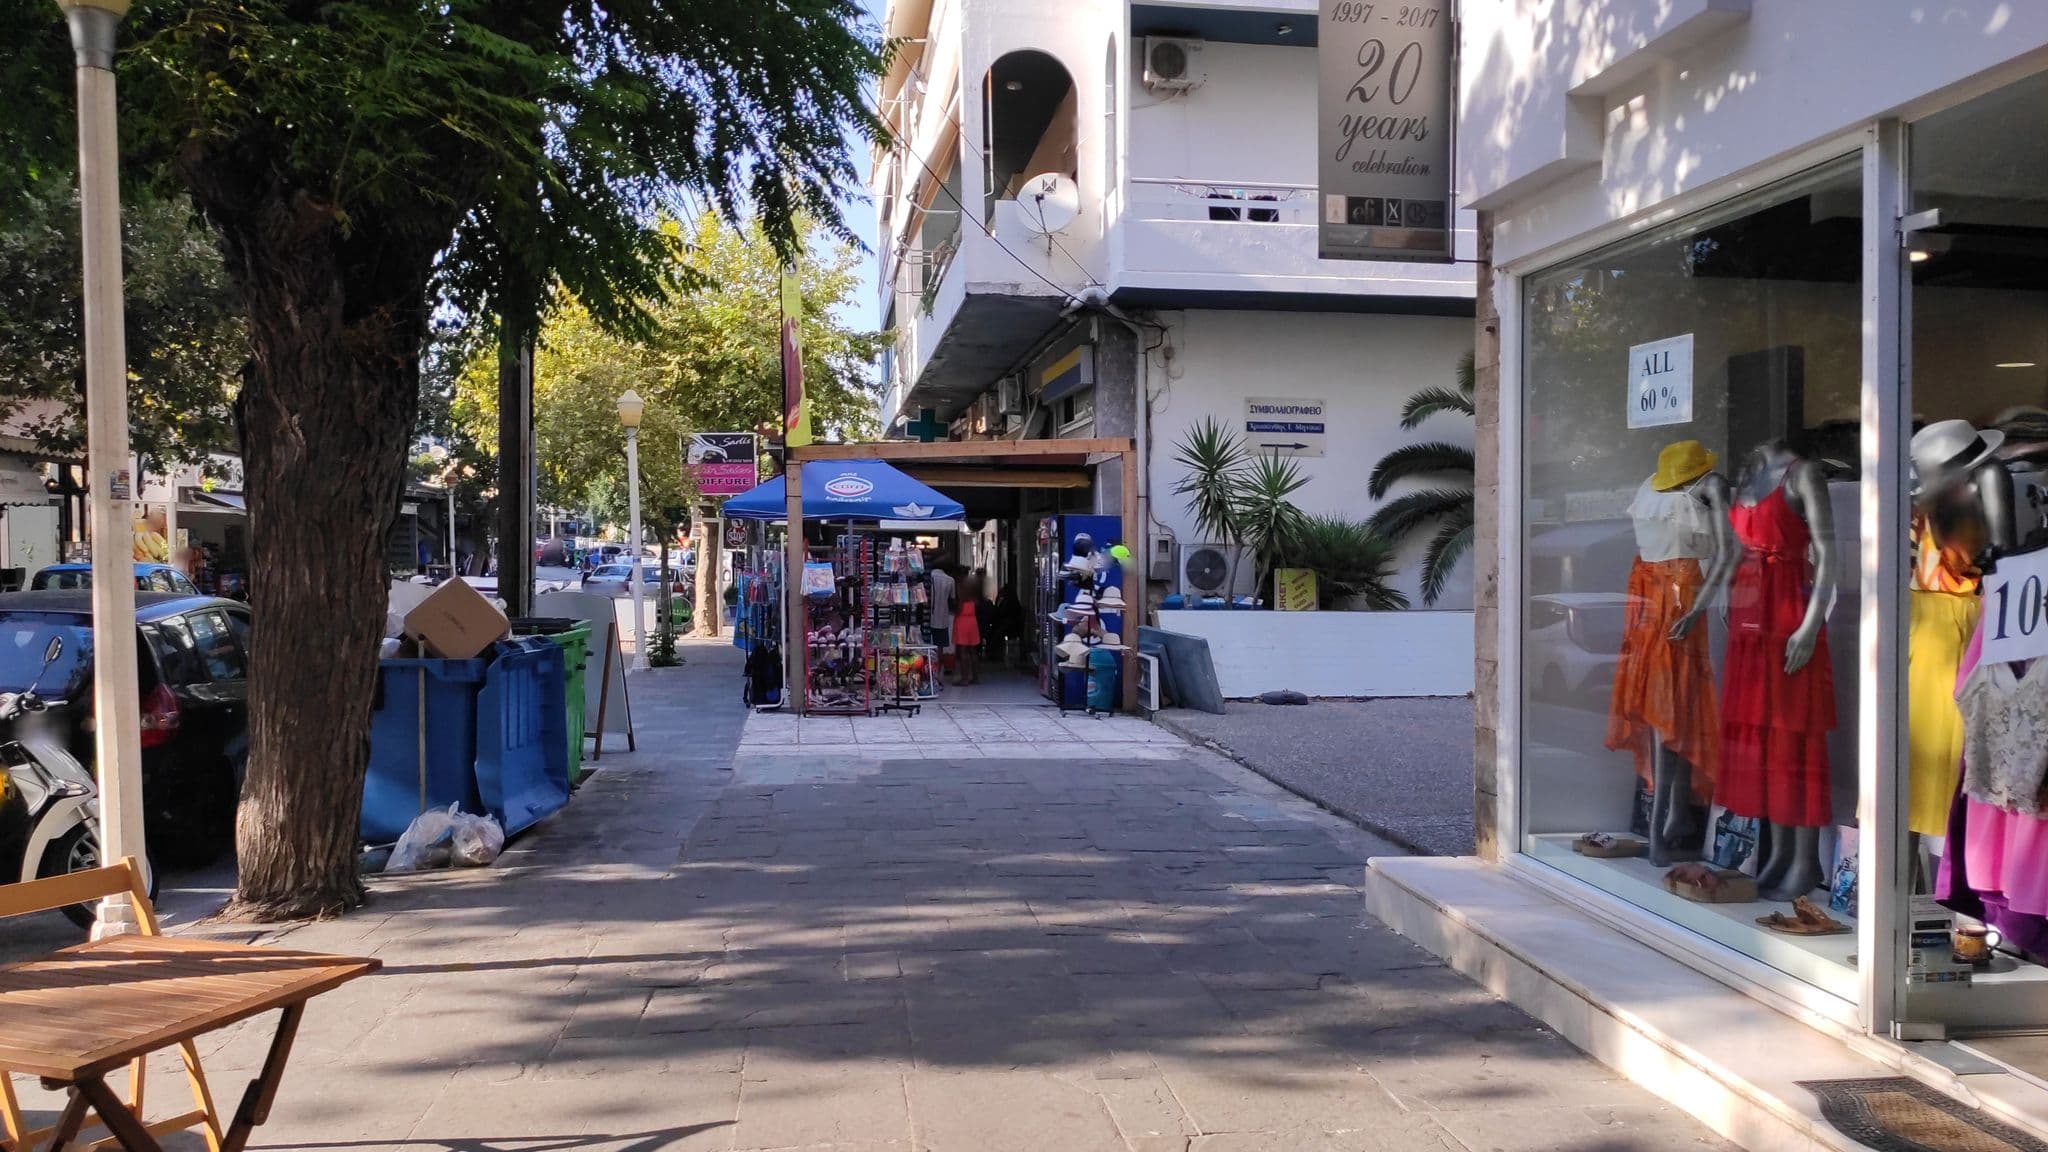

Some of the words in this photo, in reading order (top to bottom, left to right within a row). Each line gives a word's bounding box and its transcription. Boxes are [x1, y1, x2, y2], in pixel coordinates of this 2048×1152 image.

[1331, 1, 1374, 24] 1997
[1396, 6, 1440, 29] 2017
[1346, 38, 1423, 105] 20
[1335, 111, 1429, 162] years
[1352, 149, 1430, 177] celebration
[1641, 350, 1675, 377] ALL
[1641, 388, 1657, 412] 60
[1661, 385, 1677, 409] %
[1991, 574, 2048, 641] 10
